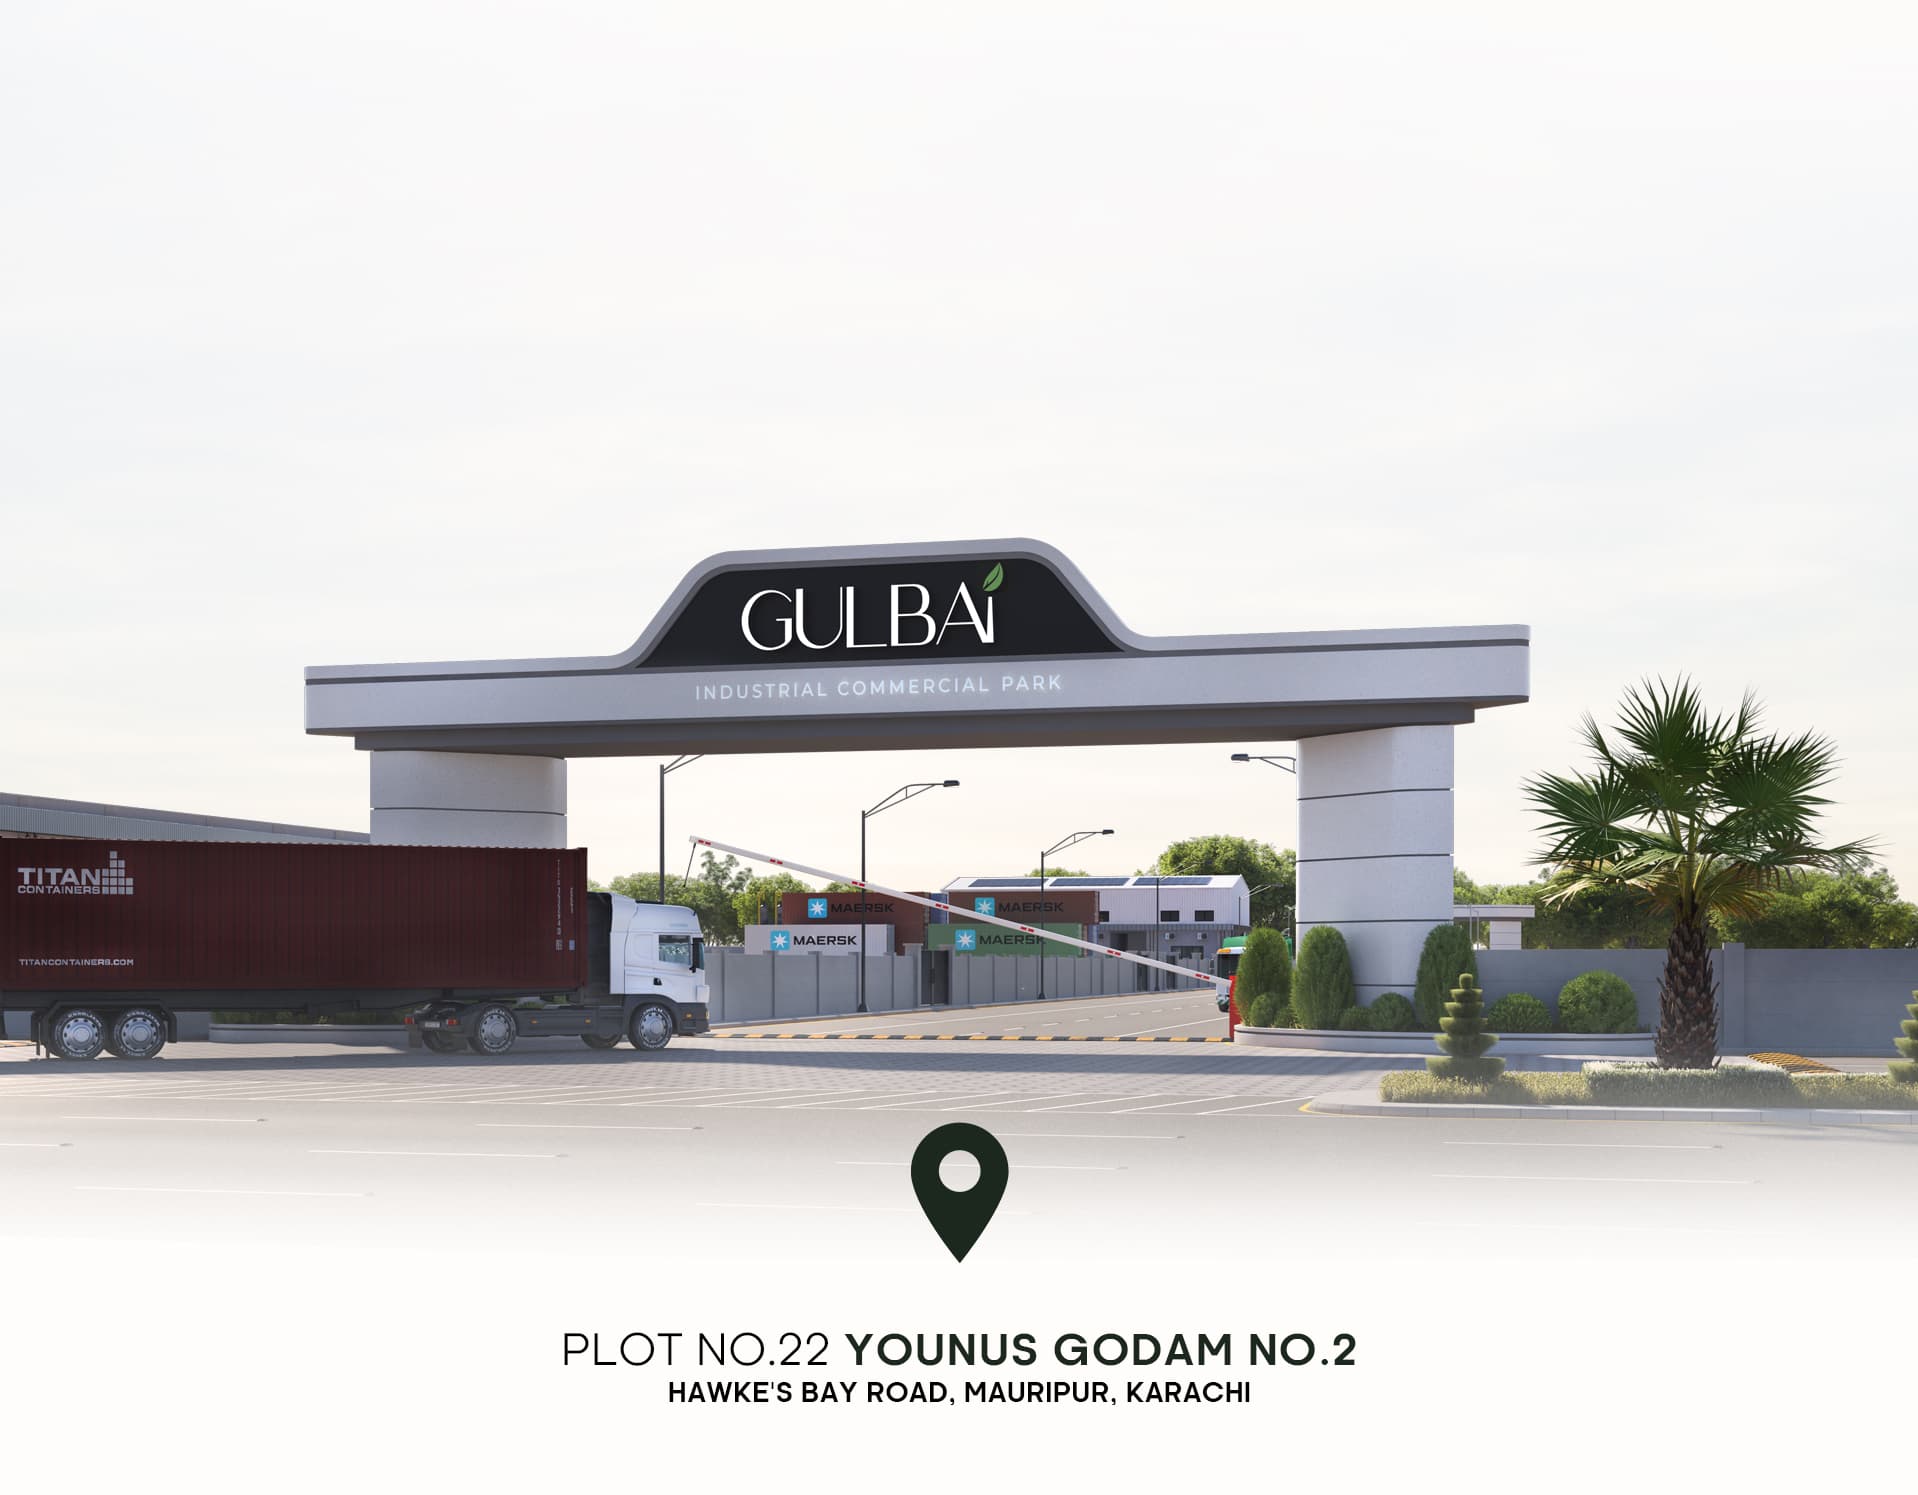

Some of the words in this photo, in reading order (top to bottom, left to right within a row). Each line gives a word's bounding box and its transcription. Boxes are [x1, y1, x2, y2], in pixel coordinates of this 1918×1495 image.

[695, 682, 827, 701] INDUSTRIAL
[837, 677, 990, 697] COMMERCIAL
[1001, 674, 1063, 692] PARK
[17, 867, 100, 886] TITAN
[17, 885, 101, 895] CONTAINERS
[831, 903, 894, 913] MAERSK
[999, 901, 1064, 913] MAERSK
[793, 935, 857, 946] MAERSK
[18, 958, 134, 967] TITANCONTAINERS.COM
